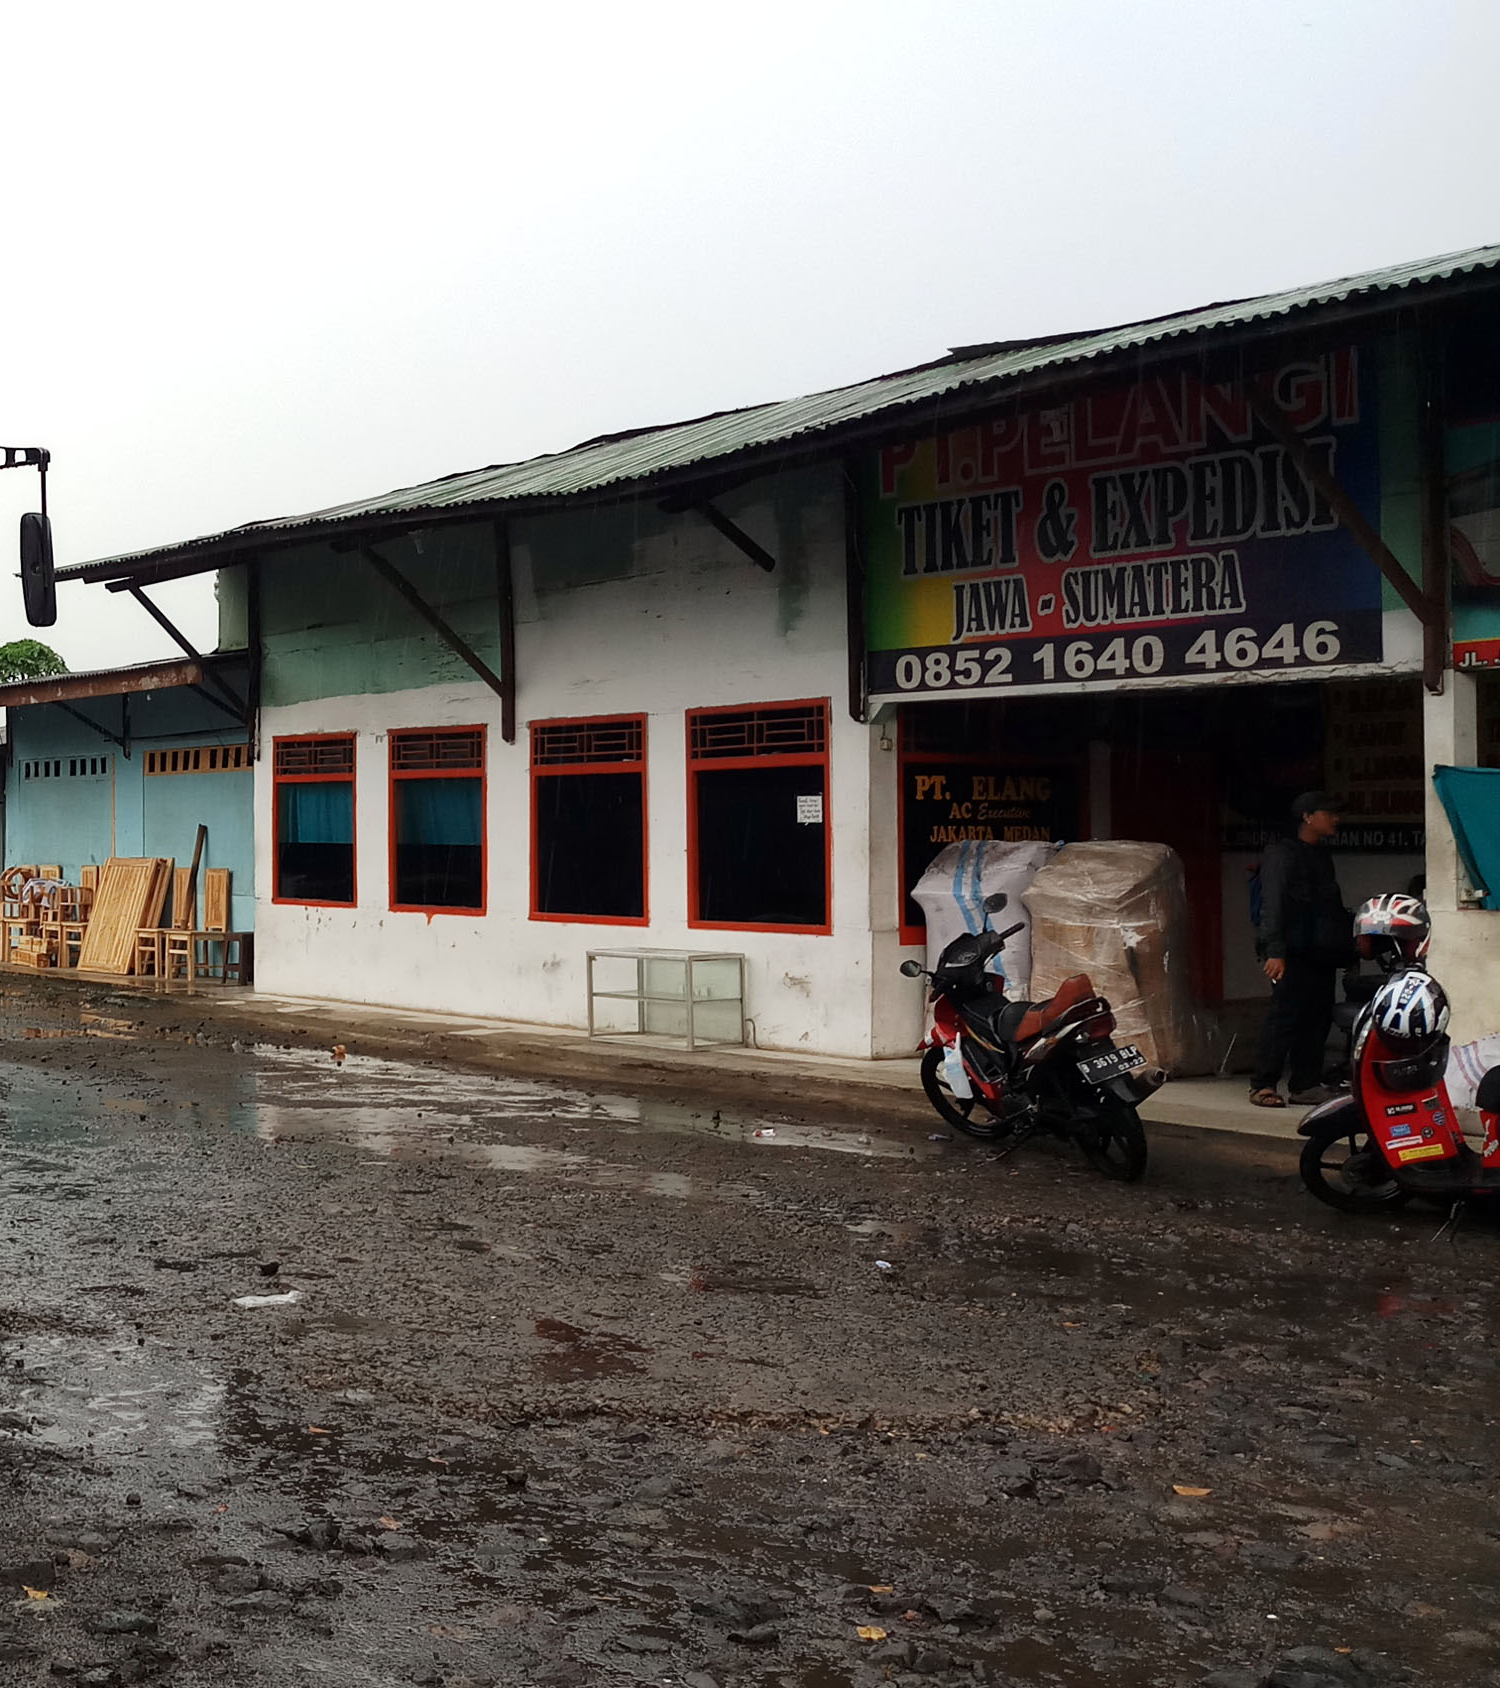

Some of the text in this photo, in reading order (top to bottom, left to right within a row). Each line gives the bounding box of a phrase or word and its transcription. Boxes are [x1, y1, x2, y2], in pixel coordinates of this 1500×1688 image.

[896, 436, 1341, 579] TIKET & EXPEDISI
[951, 574, 1033, 644] JAWA
[1062, 549, 1247, 628] SUMATERA
[895, 620, 1342, 690] 0852 1640 4646
[1458, 652, 1488, 667] JL.
[915, 774, 1052, 800] PT. ELANG
[949, 801, 973, 820] AC
[929, 825, 1051, 843] JAKARTA MEDAN
